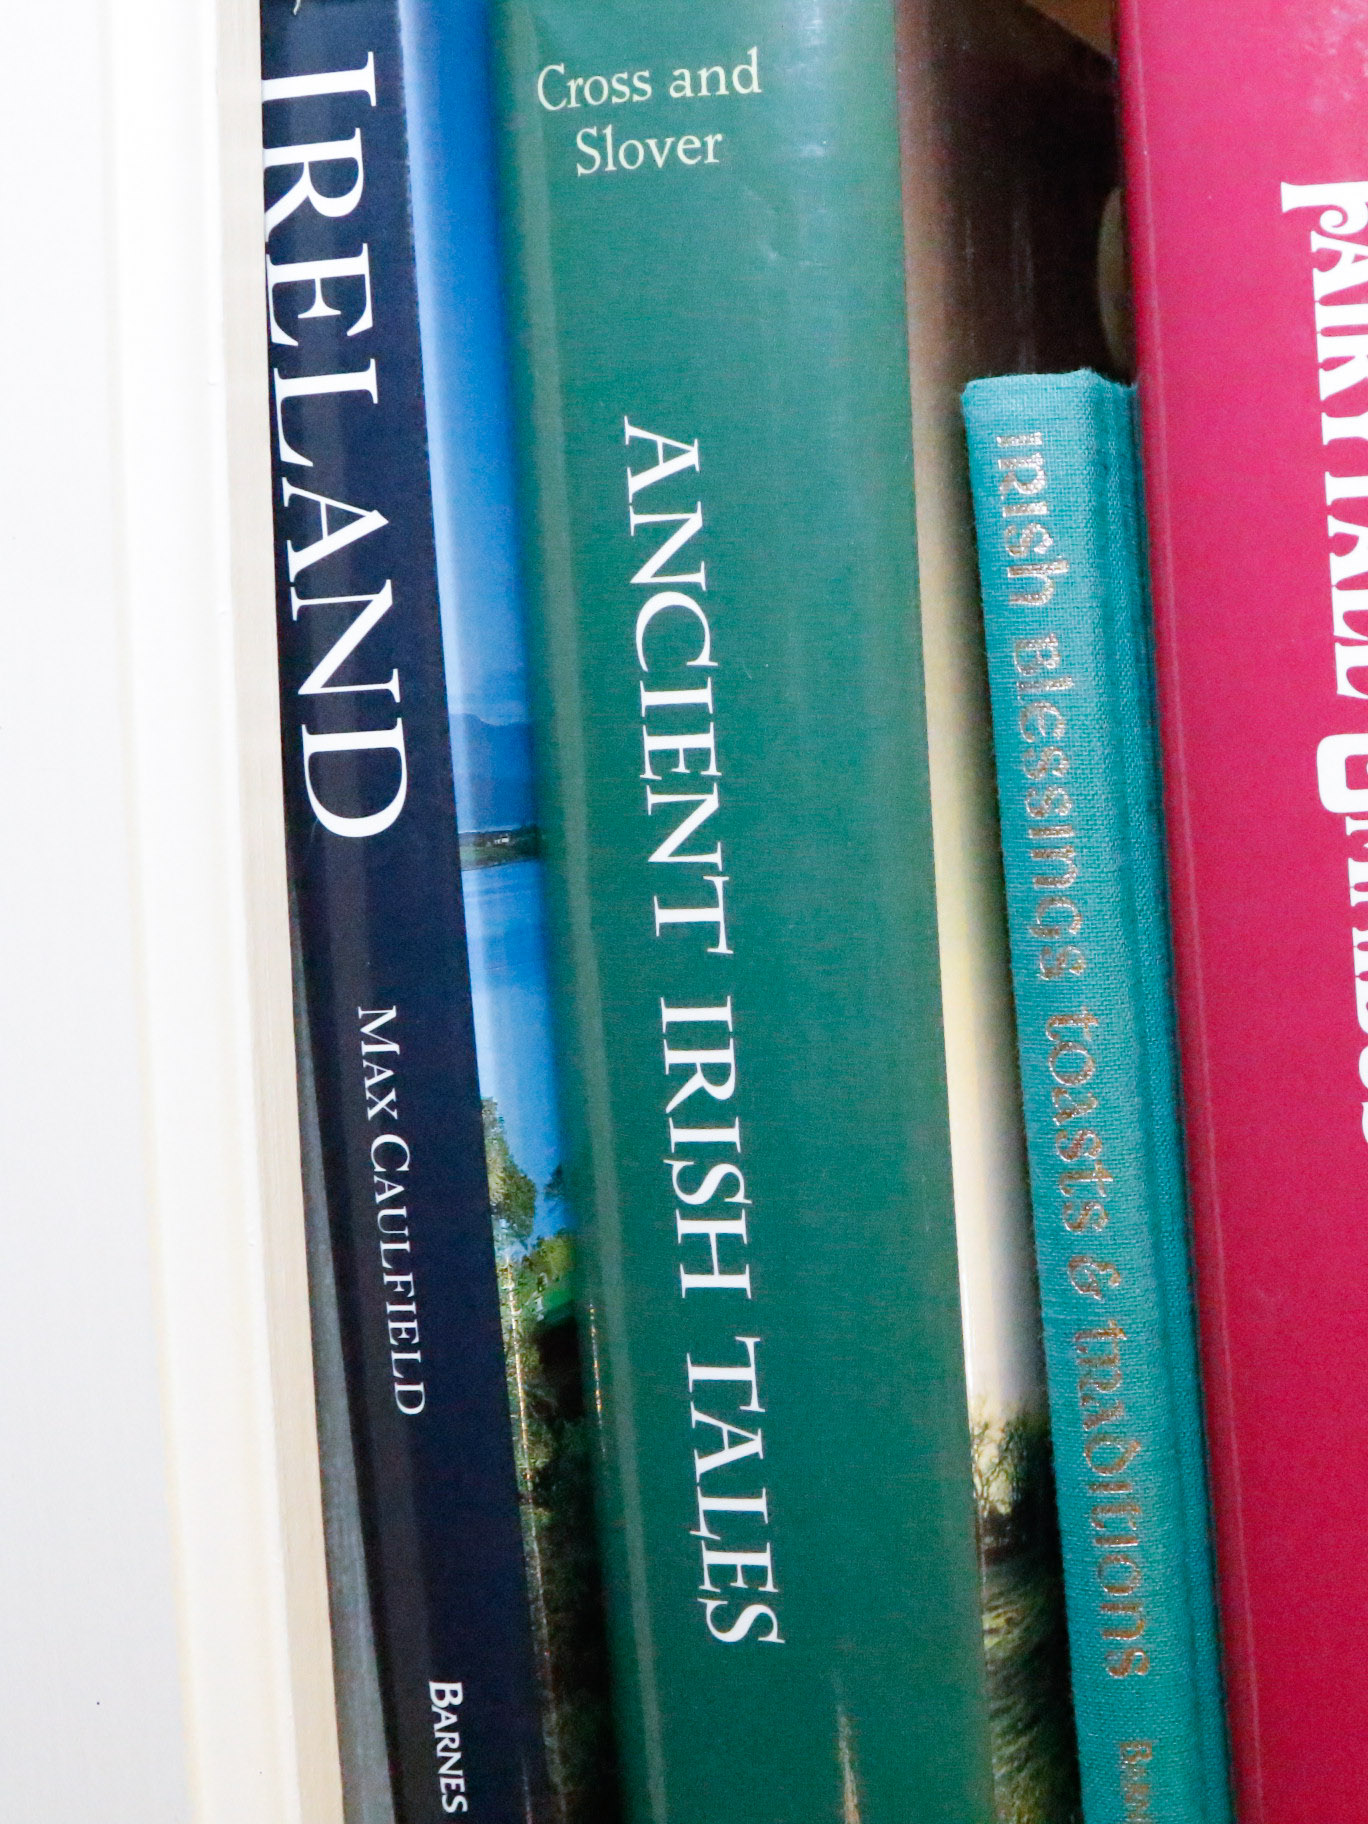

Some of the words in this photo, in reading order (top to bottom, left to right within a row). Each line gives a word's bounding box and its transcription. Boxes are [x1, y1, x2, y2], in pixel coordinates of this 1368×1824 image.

[536, 63, 653, 111] Cross
[669, 45, 763, 99] and
[576, 124, 723, 177] Slover
[261, 51, 409, 838] IRELAND
[623, 415, 734, 955] ANCIENT
[357, 1005, 400, 1120] MAX
[660, 995, 752, 1299] IRISH
[370, 1134, 425, 1415] CAULFIELD
[686, 1336, 785, 1644] TALES
[428, 1681, 468, 1813] BARNES
